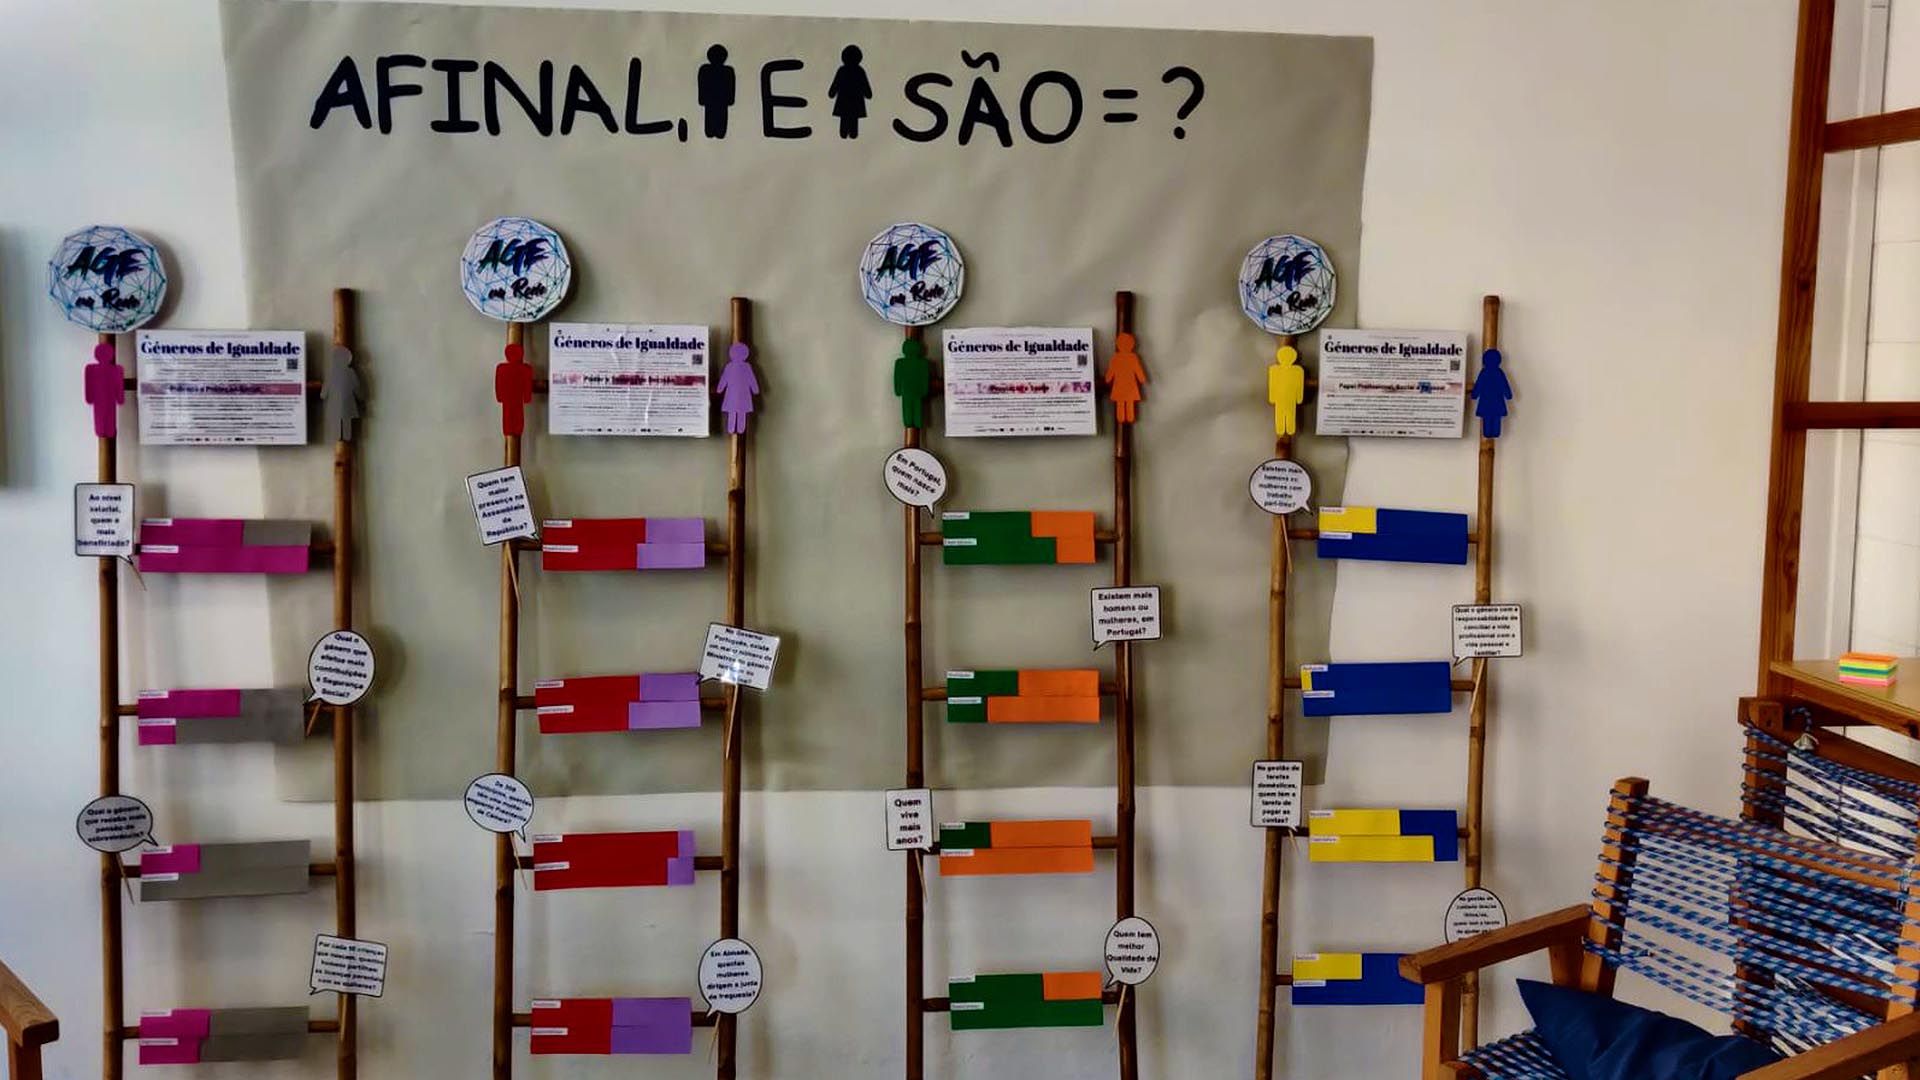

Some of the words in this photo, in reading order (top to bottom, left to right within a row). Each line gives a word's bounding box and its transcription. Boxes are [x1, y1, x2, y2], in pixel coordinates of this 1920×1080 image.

[309, 55, 688, 142] AFINAL,
[761, 59, 812, 139] E
[892, 49, 1083, 148] SÃO
[476, 238, 550, 277] AGE
[875, 240, 943, 282] AGE
[63, 246, 145, 287] AGE
[1253, 251, 1316, 294] AGE
[141, 340, 203, 355] Géneros
[206, 341, 224, 355] de
[227, 341, 301, 358] Igualdade
[554, 335, 613, 350] Géneros
[616, 336, 632, 350] de
[635, 337, 705, 353] Igualdade
[947, 340, 1002, 353] Géneros
[1005, 340, 1021, 352] de
[1024, 340, 1089, 355] Igualdade
[1324, 341, 1378, 354] Géneros
[1381, 342, 1396, 354] de
[1399, 343, 1463, 358] Igualdade
[896, 453, 908, 465] Em
[477, 479, 499, 489] Quem
[501, 475, 515, 483] tem
[479, 497, 513, 509] presença
[482, 504, 524, 518] Assembleia
[1099, 616, 1139, 625] mulheres,
[335, 634, 352, 642] Qual
[1107, 627, 1146, 637] Portugal?
[324, 644, 351, 653] género
[314, 665, 367, 678] contribuições
[323, 677, 363, 689] Segurança
[894, 799, 921, 807] Quem
[900, 811, 919, 819] vive
[900, 823, 921, 831] mais
[896, 835, 923, 844] anos?
[1113, 930, 1136, 938] Quem
